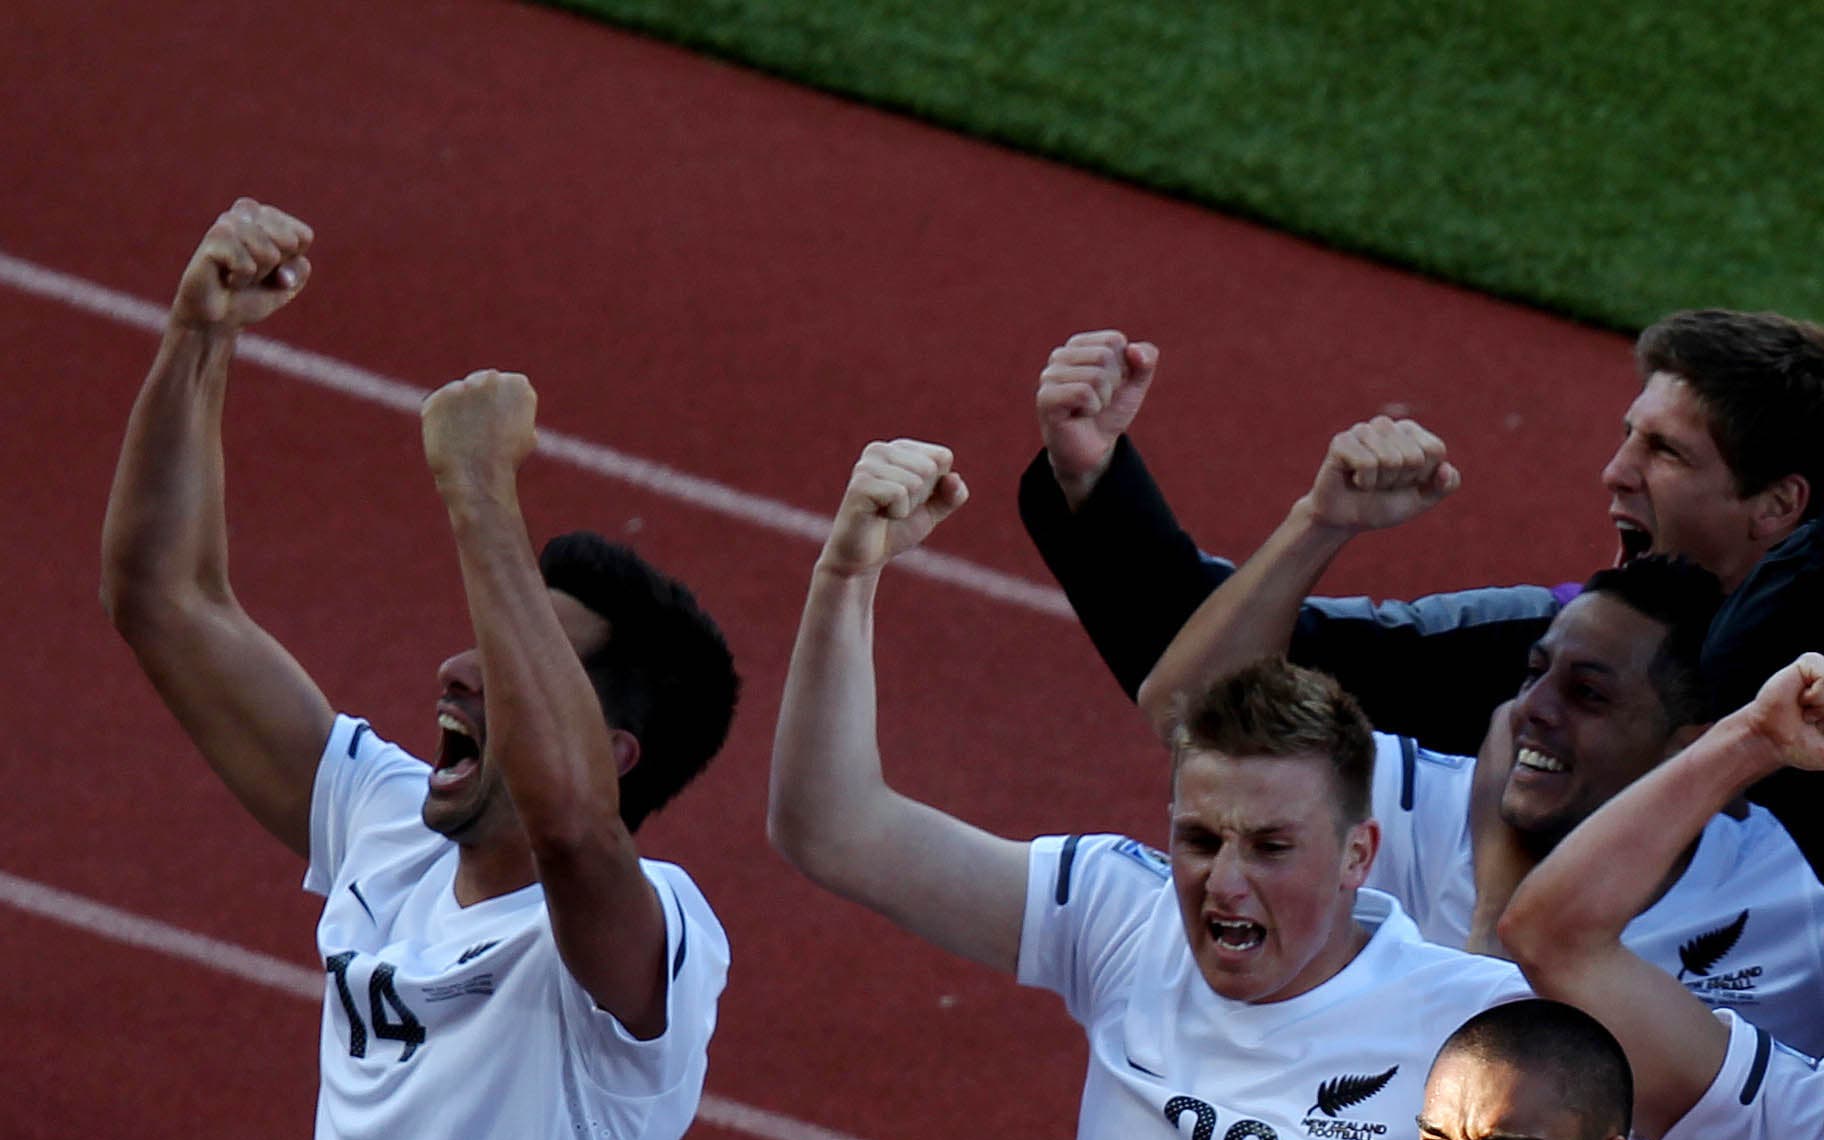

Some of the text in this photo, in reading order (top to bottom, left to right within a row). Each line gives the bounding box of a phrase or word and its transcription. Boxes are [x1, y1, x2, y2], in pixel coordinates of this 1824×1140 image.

[327, 950, 426, 1062] 14
[1301, 1118, 1387, 1135] NEW ZEALAND
